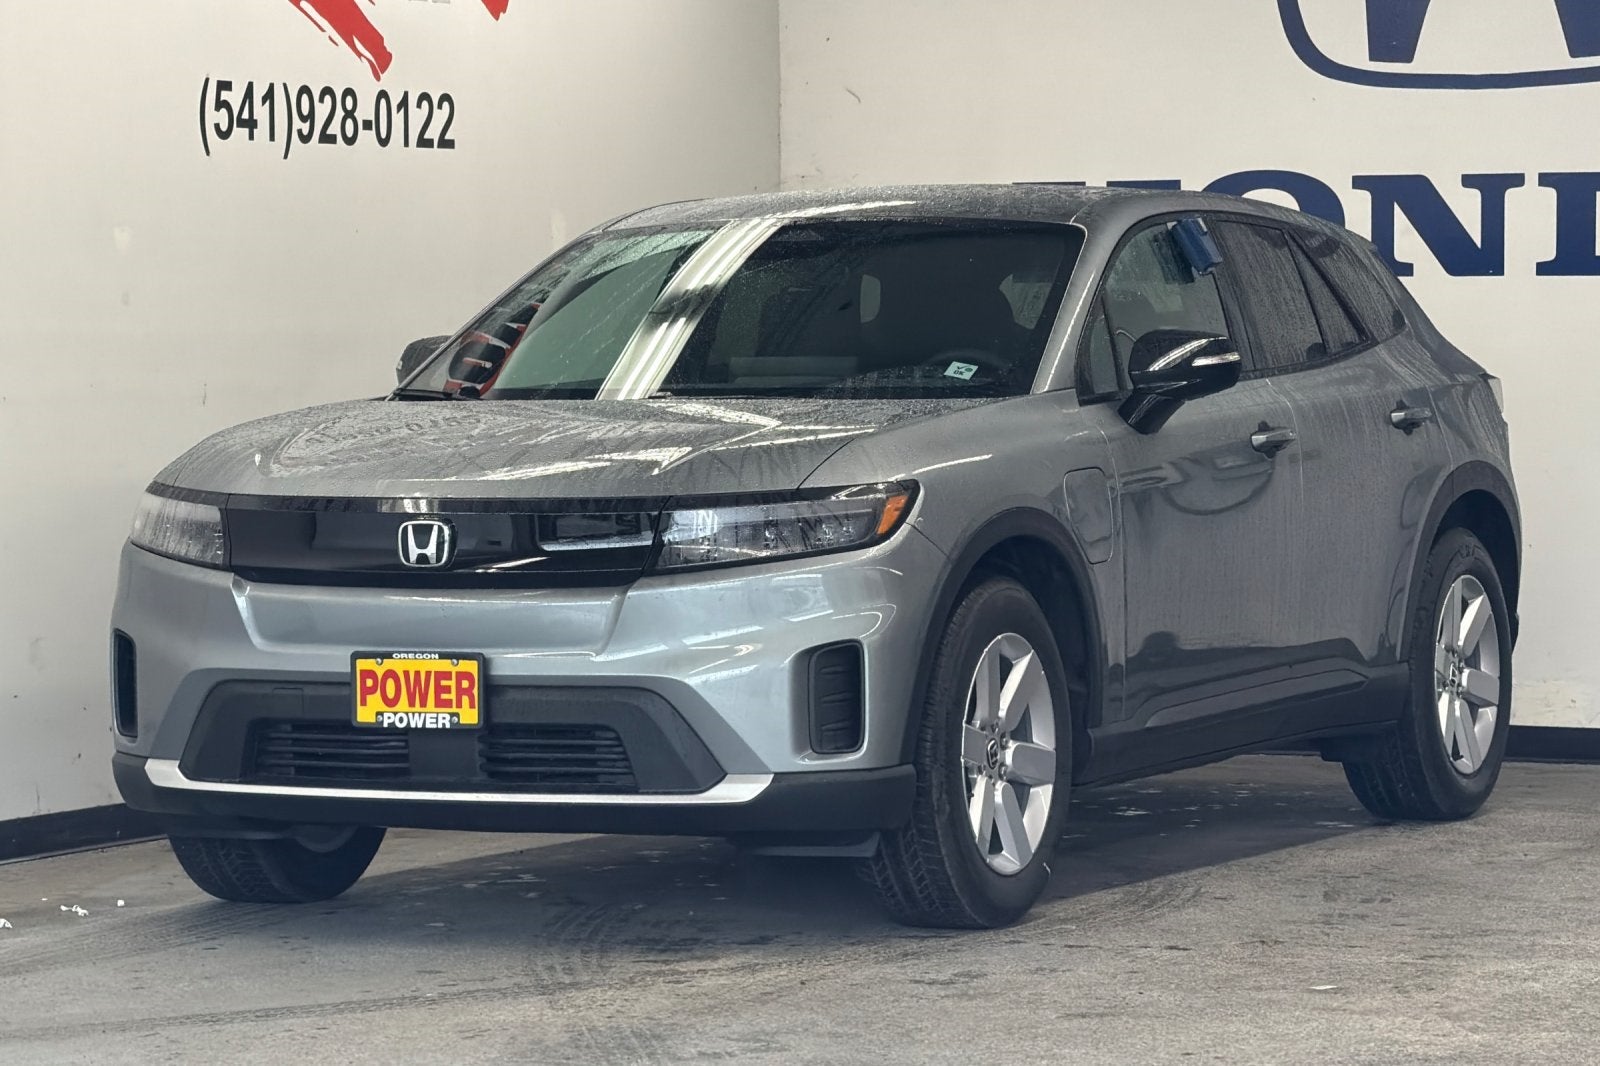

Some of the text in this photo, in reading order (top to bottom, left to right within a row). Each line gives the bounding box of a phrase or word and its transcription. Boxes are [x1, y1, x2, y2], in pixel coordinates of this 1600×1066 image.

[200, 76, 455, 160] (541)928-0122
[359, 668, 476, 709] POWER
[383, 712, 451, 729] POWER
